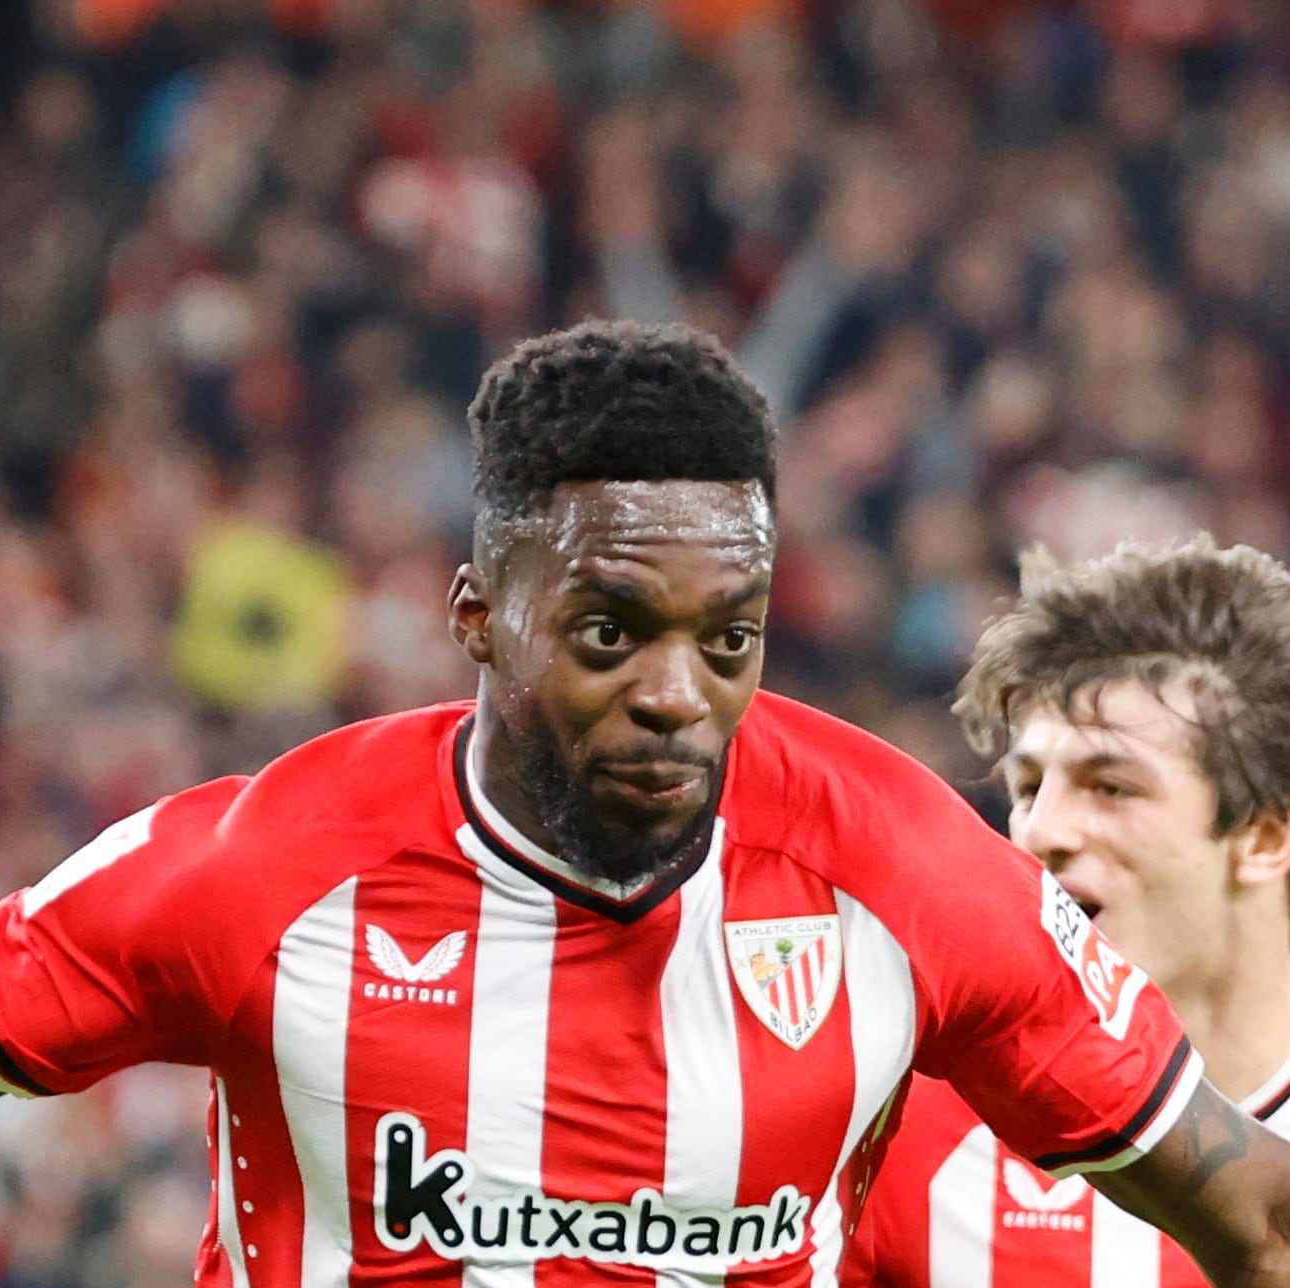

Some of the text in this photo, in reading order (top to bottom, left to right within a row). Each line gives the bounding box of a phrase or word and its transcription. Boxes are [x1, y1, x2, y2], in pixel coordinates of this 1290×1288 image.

[734, 921, 831, 937] ATHLETIC CLUB
[1086, 930, 1125, 1003] PA
[364, 982, 457, 1005] CASTORE
[769, 1007, 817, 1043] BILBAO
